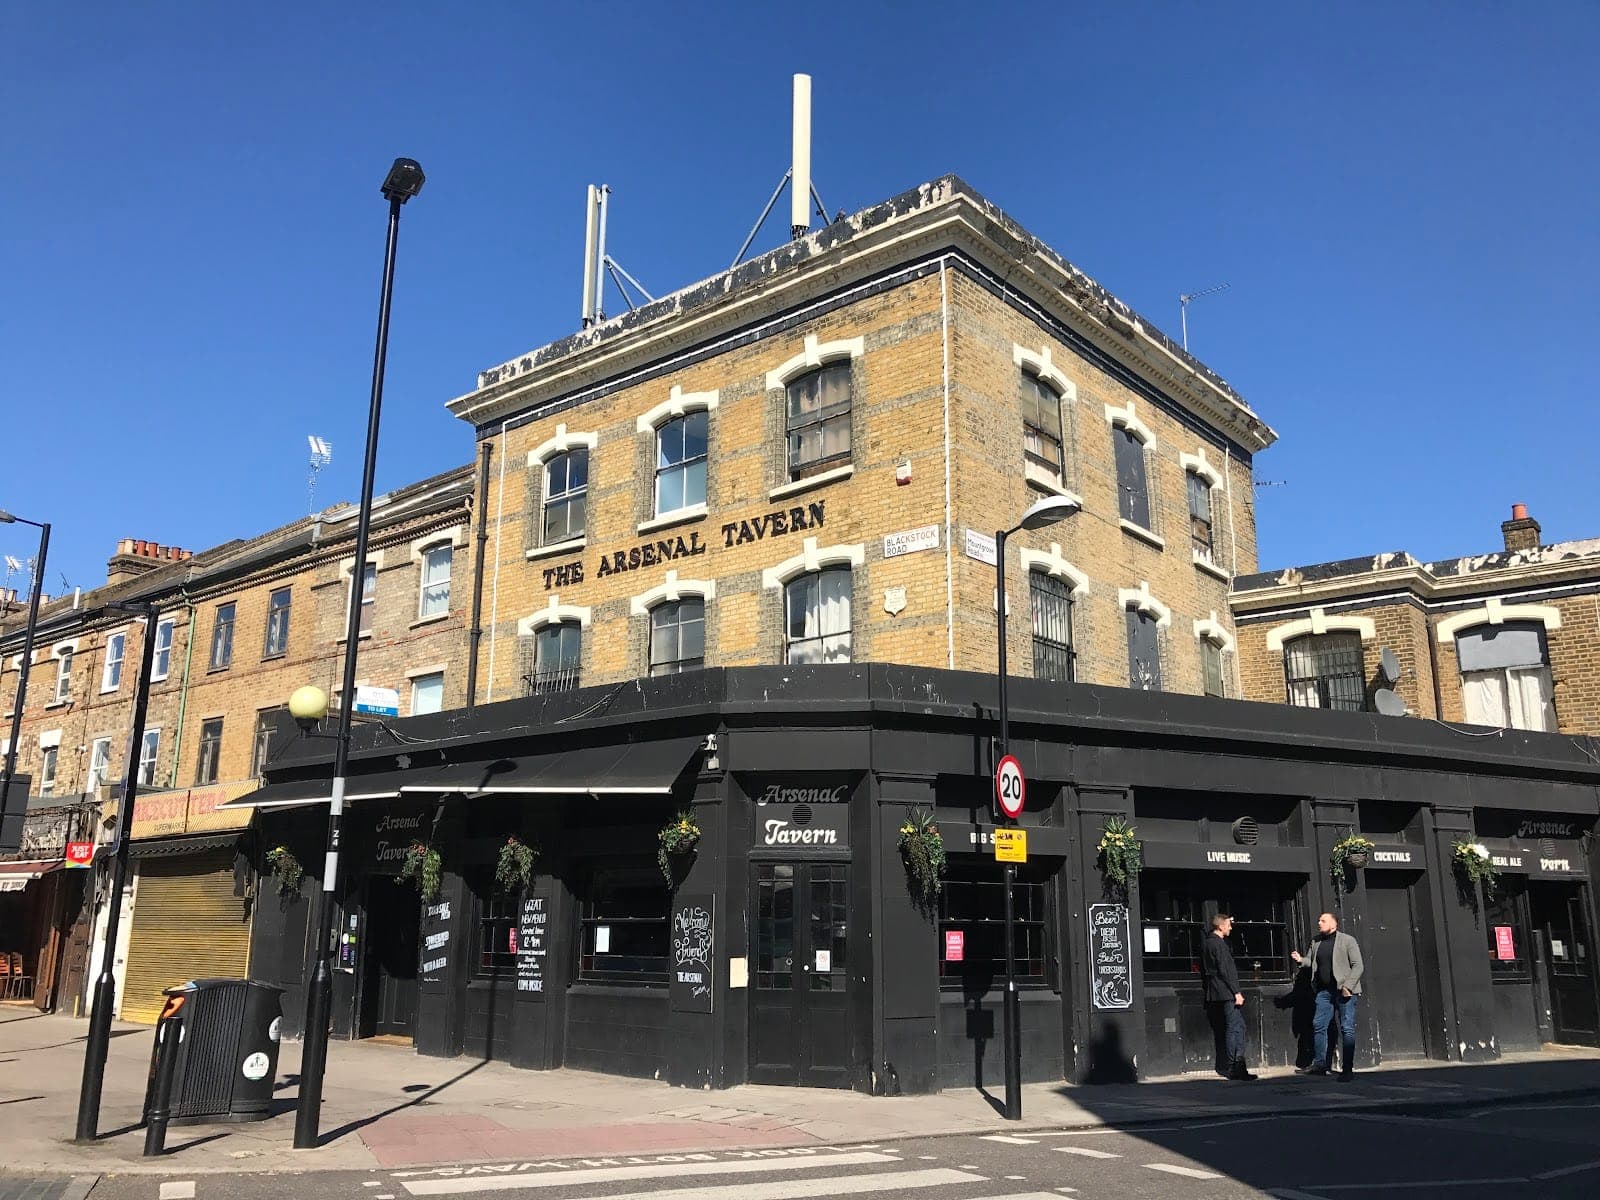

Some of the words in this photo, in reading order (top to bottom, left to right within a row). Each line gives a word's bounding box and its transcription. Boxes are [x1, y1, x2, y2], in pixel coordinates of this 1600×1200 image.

[543, 560, 584, 590] THE
[597, 531, 706, 578] ARSENAL
[721, 500, 826, 547] TAVERN
[886, 529, 937, 547] BLACKSTOCK
[886, 545, 908, 556] ROAD
[757, 784, 849, 806] Arsenal
[1002, 773, 1021, 800] 20
[375, 813, 425, 833] Arsenal
[1517, 820, 1576, 837] Arsenal
[765, 819, 838, 845] Tavern
[71, 845, 90, 853] JUST
[74, 851, 90, 859] EAT
[376, 841, 409, 861] Taver
[1207, 851, 1226, 862] LIVE
[1227, 852, 1251, 863] MUSIC
[1374, 851, 1411, 862] COCKTAILS
[1509, 857, 1522, 867] ALE
[725, 1143, 843, 1160] LOOK
[581, 1153, 718, 1168] BOTH
